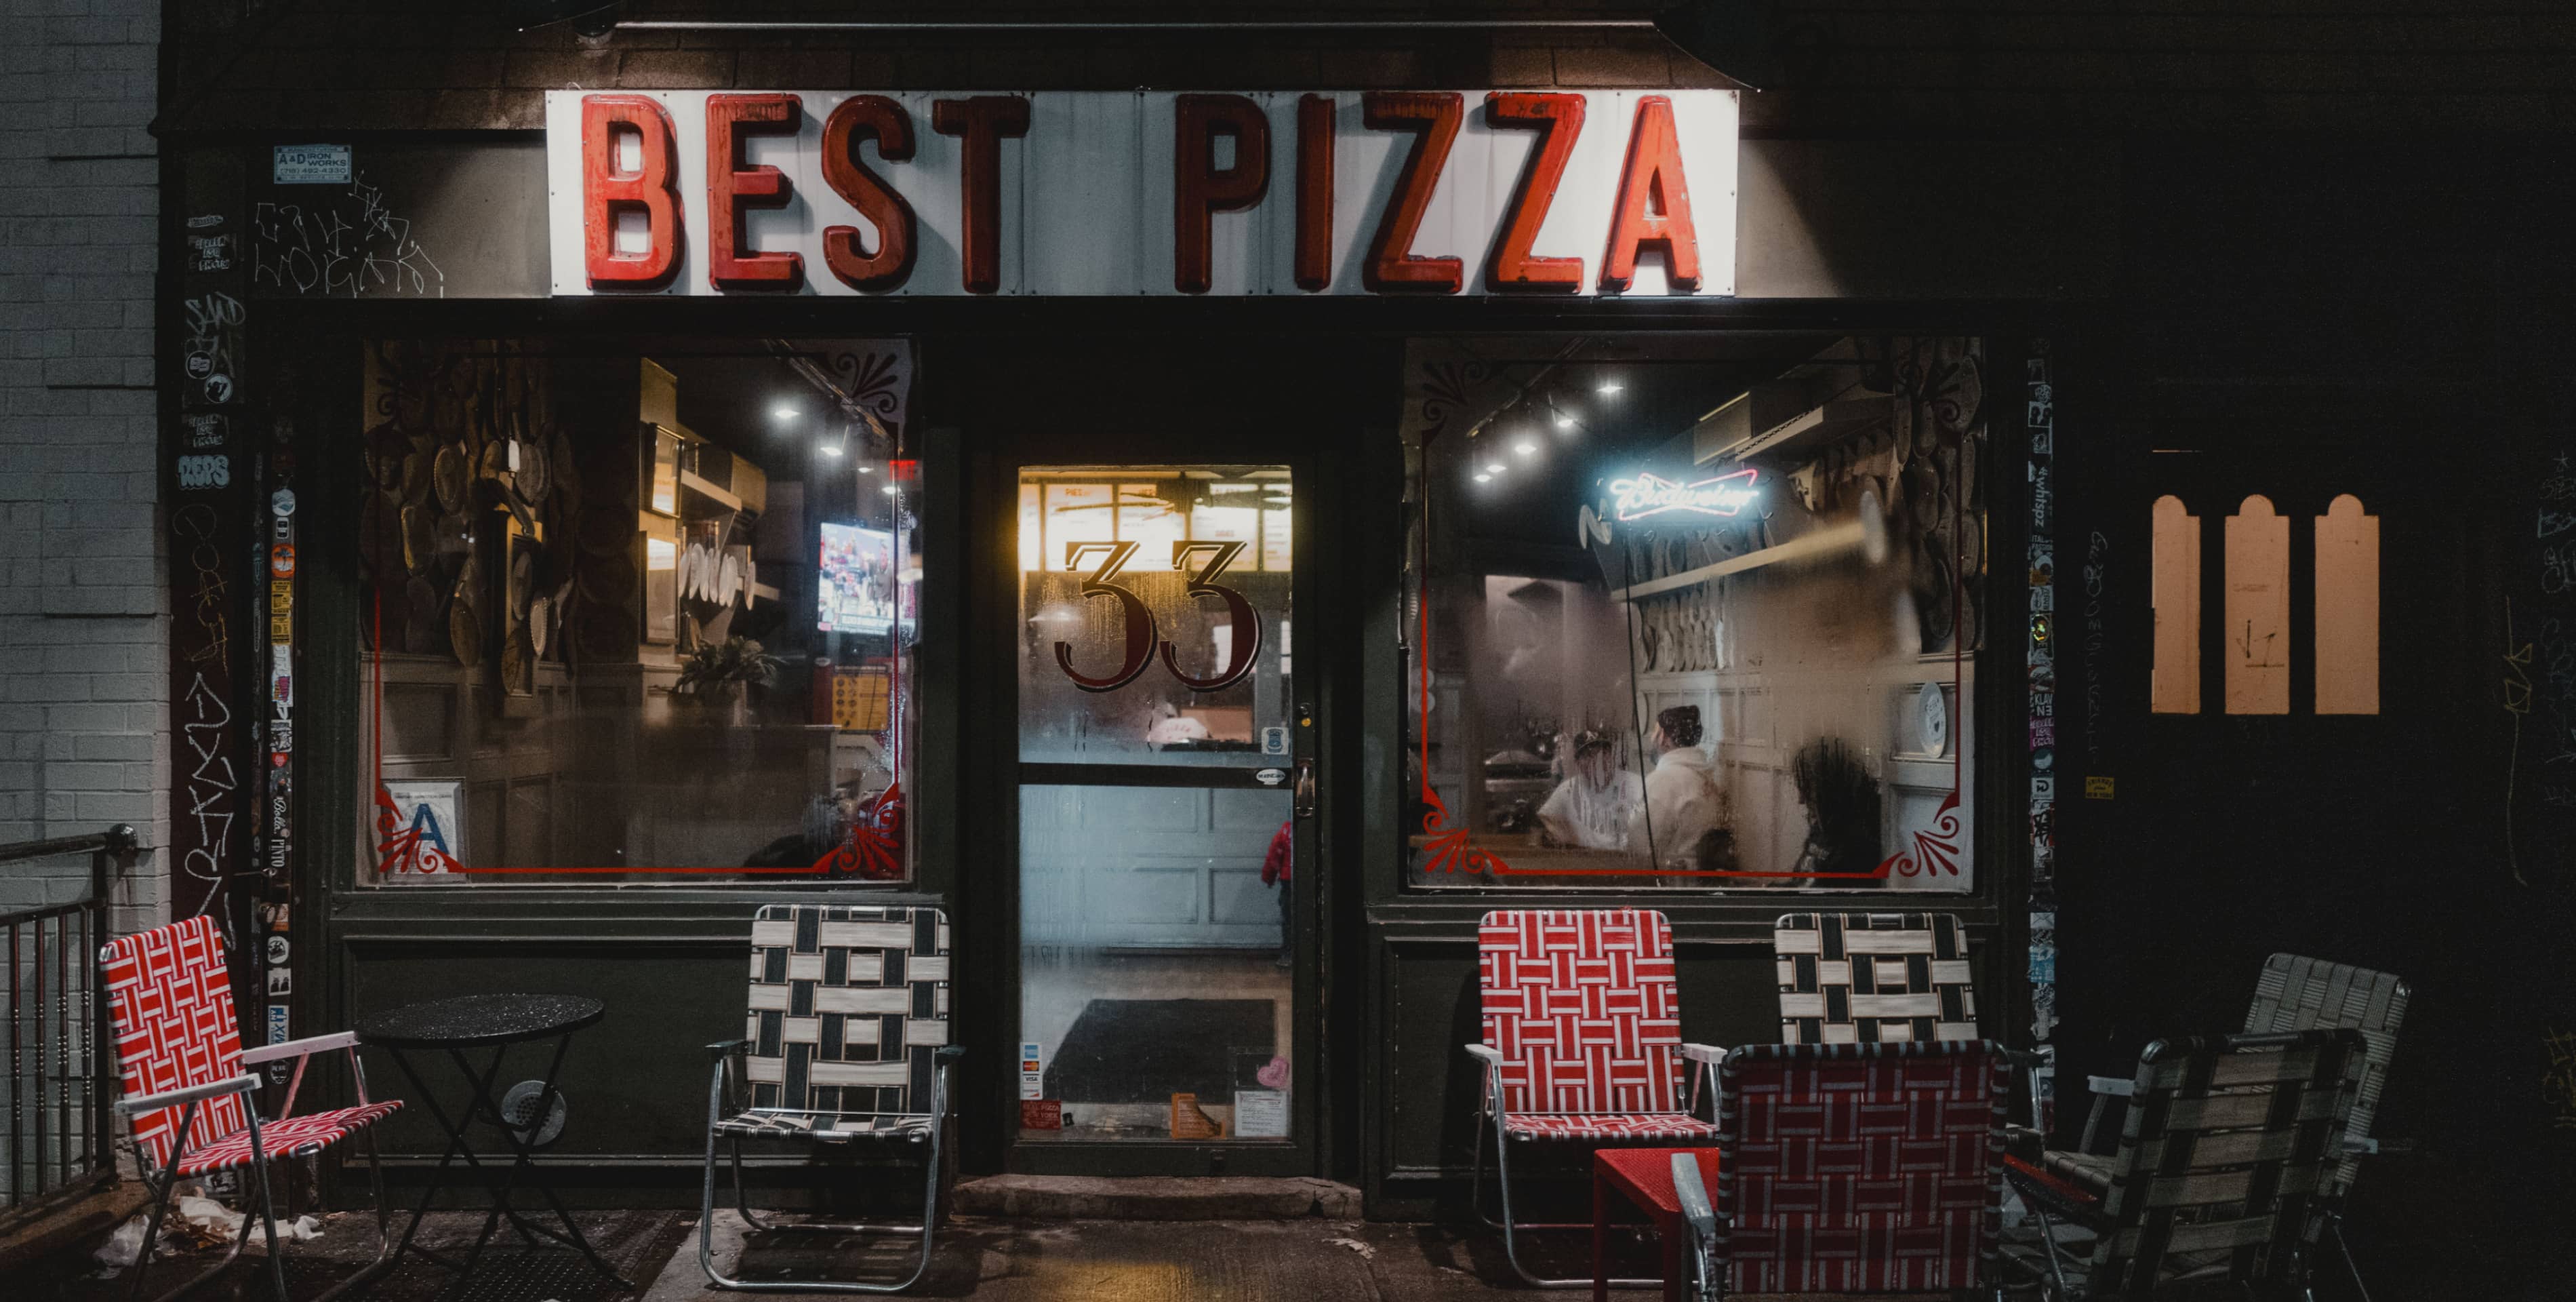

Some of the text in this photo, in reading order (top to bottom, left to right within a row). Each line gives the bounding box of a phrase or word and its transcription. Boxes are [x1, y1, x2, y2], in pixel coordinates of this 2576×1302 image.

[279, 154, 287, 164] A
[297, 153, 306, 164] D
[582, 92, 1704, 294] BEST PIZZA
[1609, 475, 1760, 509] Budweiser
[1054, 540, 1263, 692] 33
[402, 803, 450, 856] A
